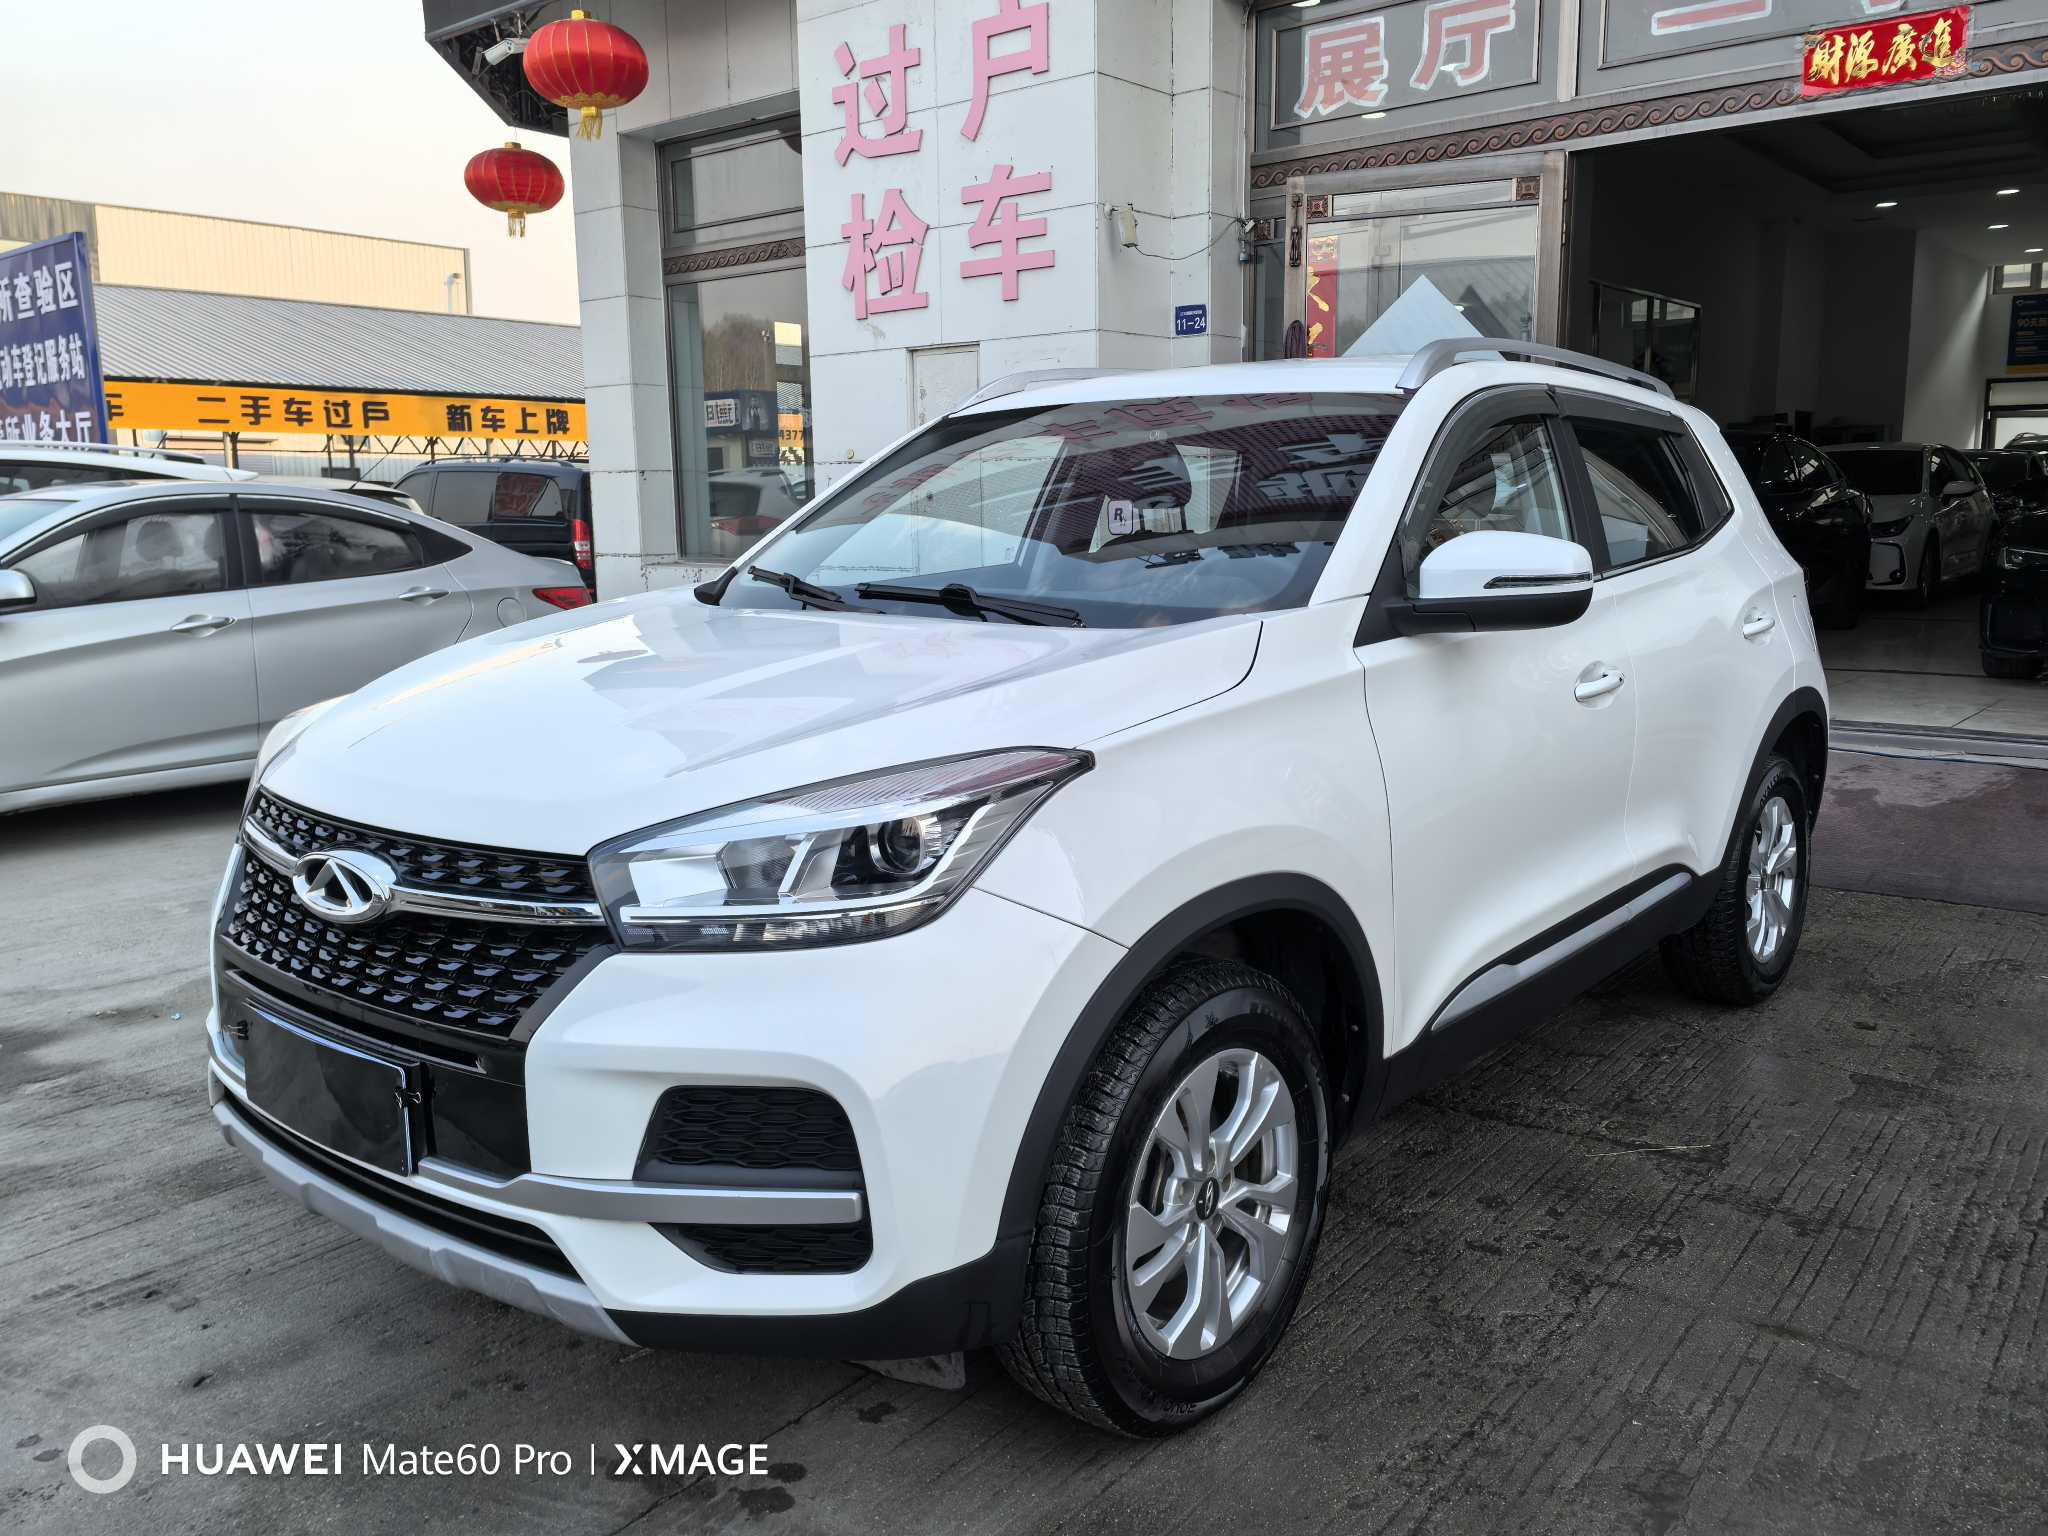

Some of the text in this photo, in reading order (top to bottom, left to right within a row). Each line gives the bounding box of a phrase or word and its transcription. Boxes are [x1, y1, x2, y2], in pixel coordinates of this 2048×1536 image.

[832, 0, 1049, 167] 过户
[1294, 0, 1516, 119] 展厅
[841, 164, 1056, 321] 检车
[1176, 316, 1206, 331] 11-24
[0, 332, 85, 390] 动车登记服务站
[0, 409, 93, 444] 所业务大厅
[197, 396, 390, 430] 二手车过户
[446, 404, 570, 434] 新车上牌
